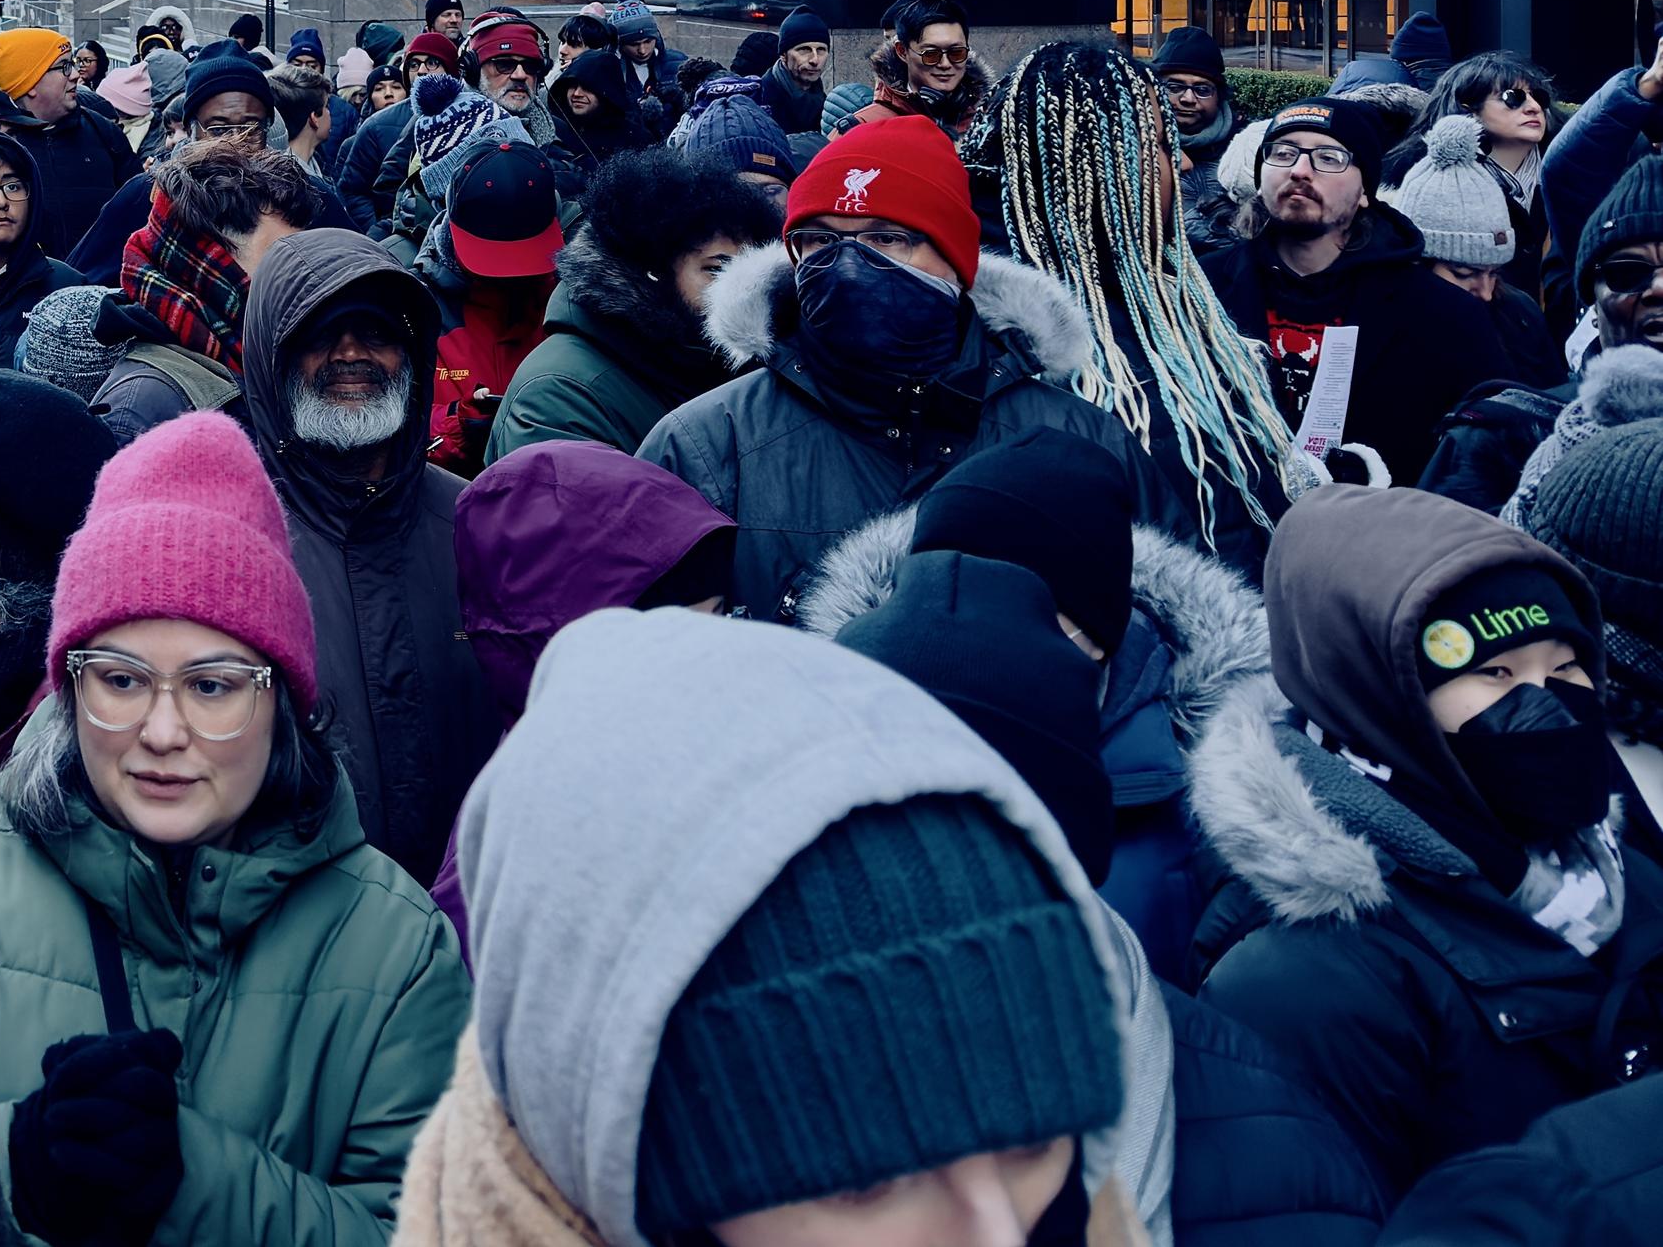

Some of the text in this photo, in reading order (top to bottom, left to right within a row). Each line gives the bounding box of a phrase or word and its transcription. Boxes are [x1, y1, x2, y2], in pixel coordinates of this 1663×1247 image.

[620, 7, 642, 19] EAST
[1293, 114, 1325, 122] MAYOR
[1307, 436, 1327, 446] VOTE
[1470, 603, 1550, 641] Lime
